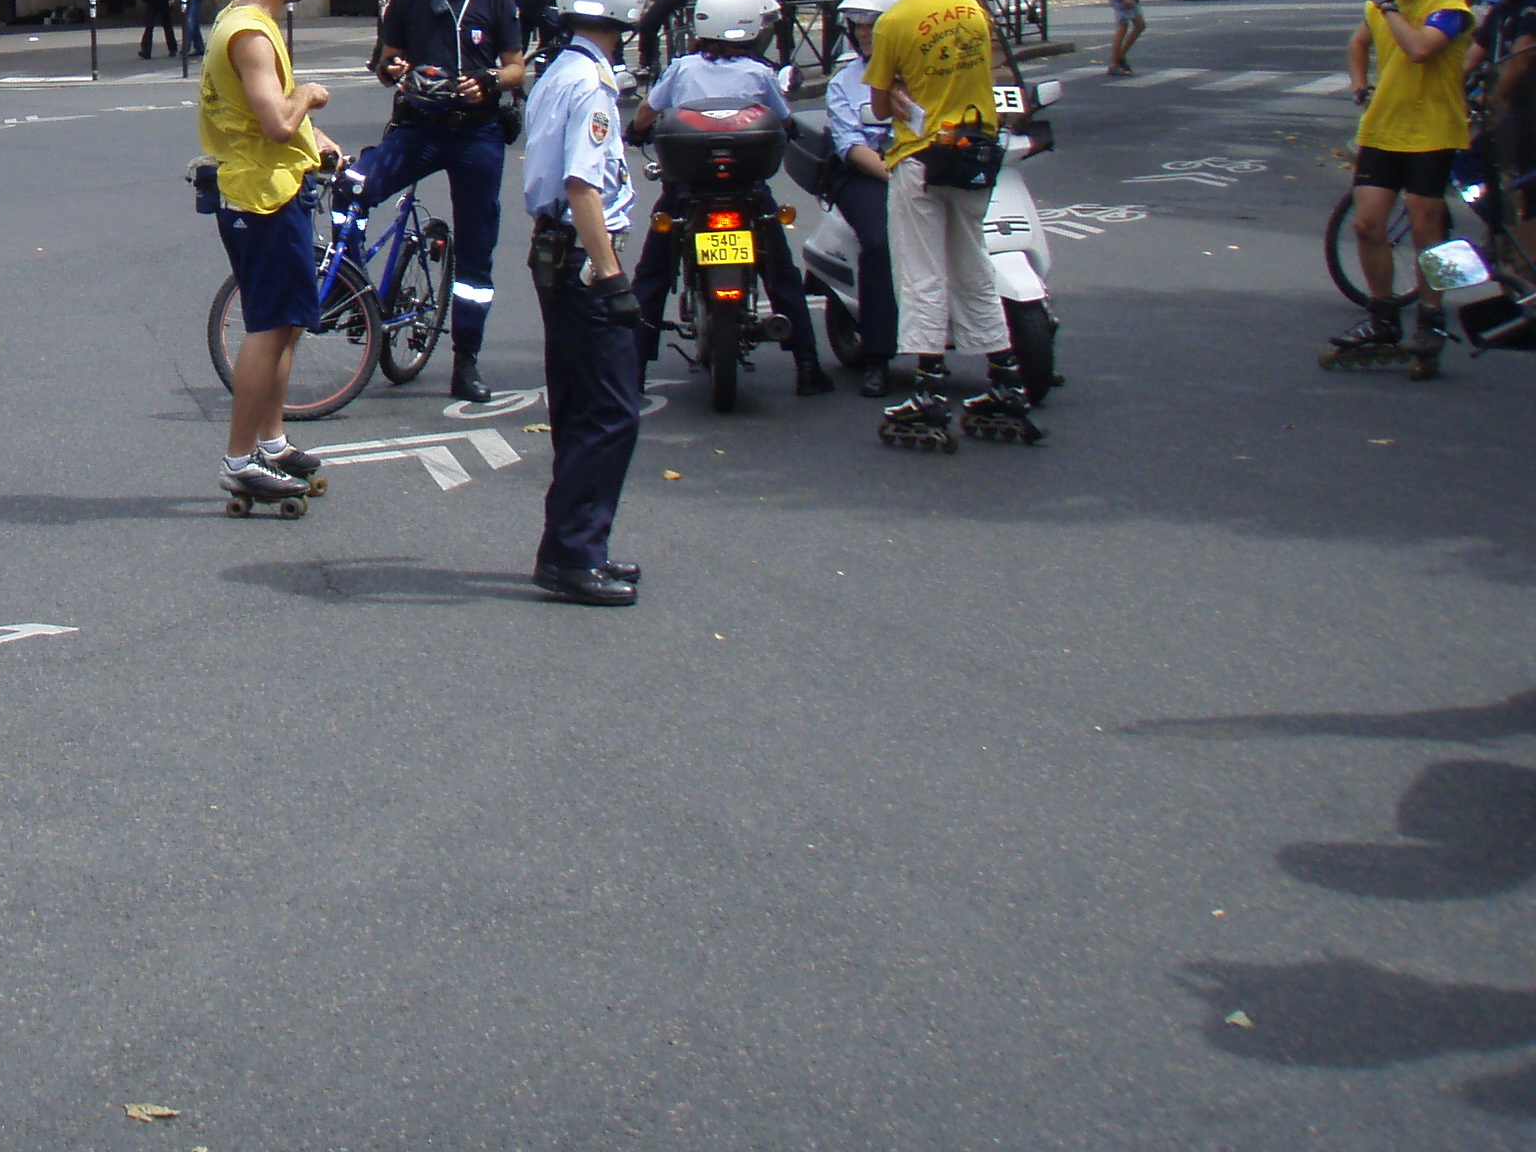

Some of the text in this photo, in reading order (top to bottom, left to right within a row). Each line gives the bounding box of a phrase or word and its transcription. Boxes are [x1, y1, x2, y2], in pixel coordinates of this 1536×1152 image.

[918, 6, 976, 36] STAFF
[710, 233, 737, 247] 540
[731, 246, 749, 260] 75
